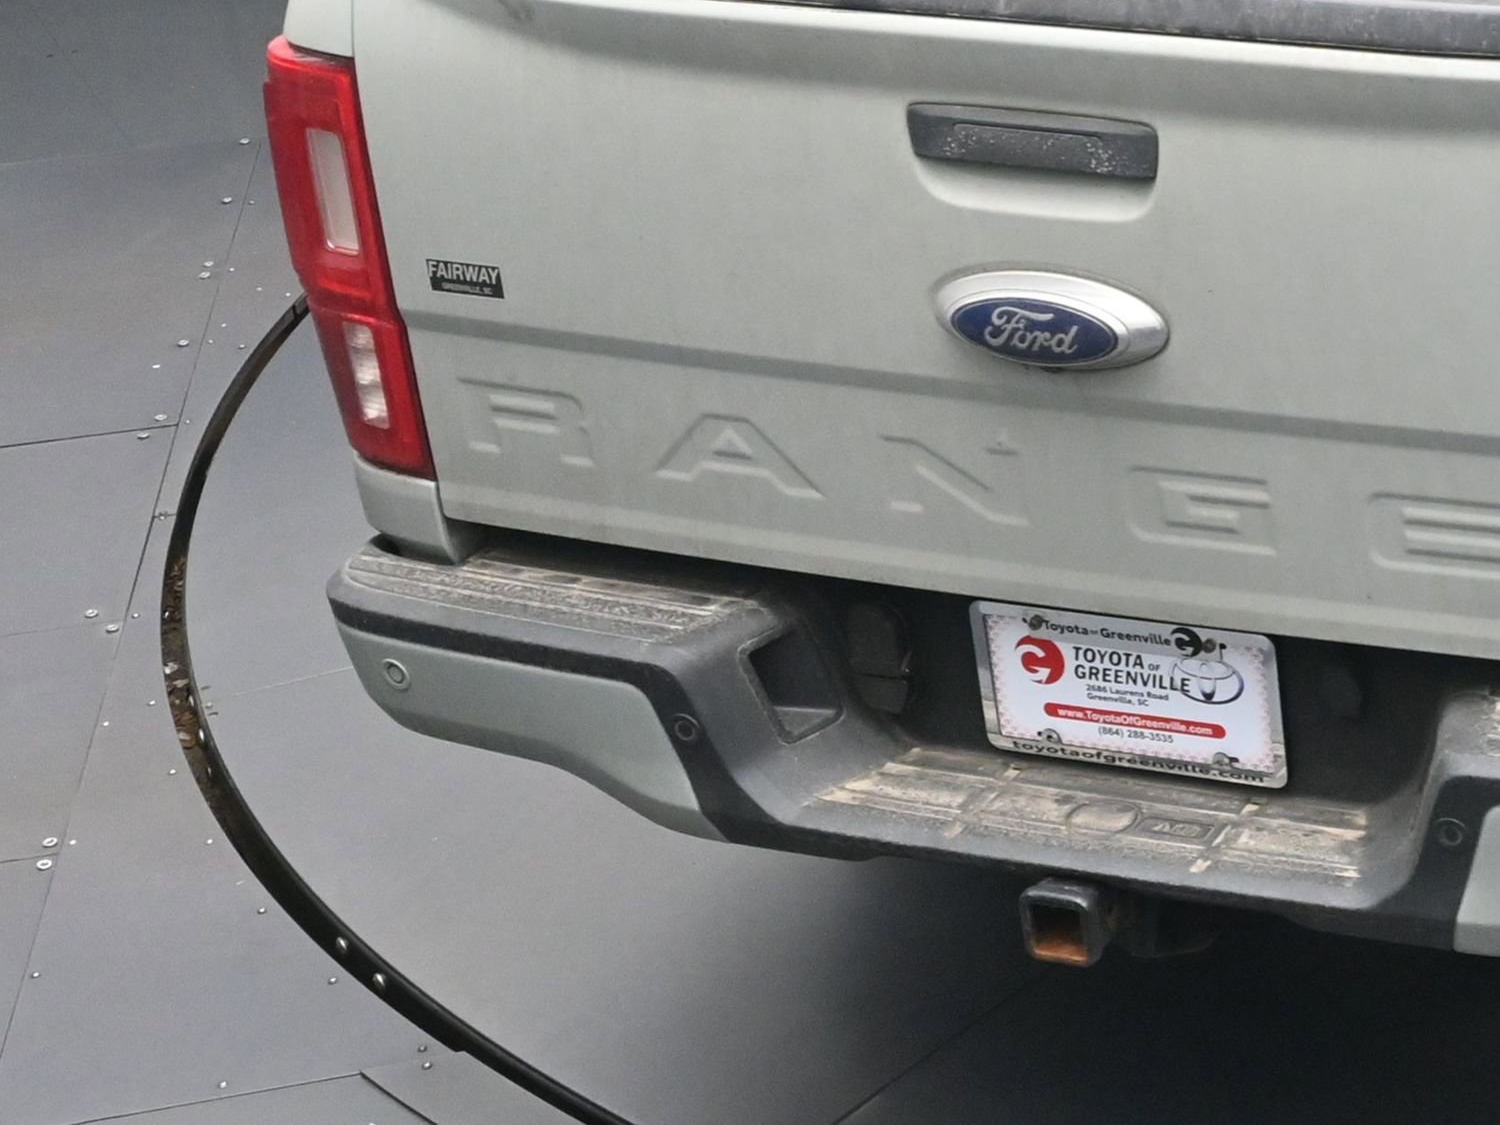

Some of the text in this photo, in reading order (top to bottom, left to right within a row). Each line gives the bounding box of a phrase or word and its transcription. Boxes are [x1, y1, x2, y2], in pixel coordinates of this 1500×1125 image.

[428, 261, 499, 284] FAIRWAY
[984, 306, 1079, 355] Ford
[1042, 619, 1089, 635] Toyota
[1100, 627, 1172, 646] Greenville
[1073, 646, 1161, 672] TOYOTA OF
[1074, 664, 1191, 693] GREENVILLE
[1109, 687, 1145, 698] Laurens
[1147, 691, 1169, 701] Road
[1137, 698, 1149, 707] SC
[1056, 708, 1213, 736] www.ToyotaOfGreenville.com
[1012, 740, 1265, 783] toyotaofgreenville.com
